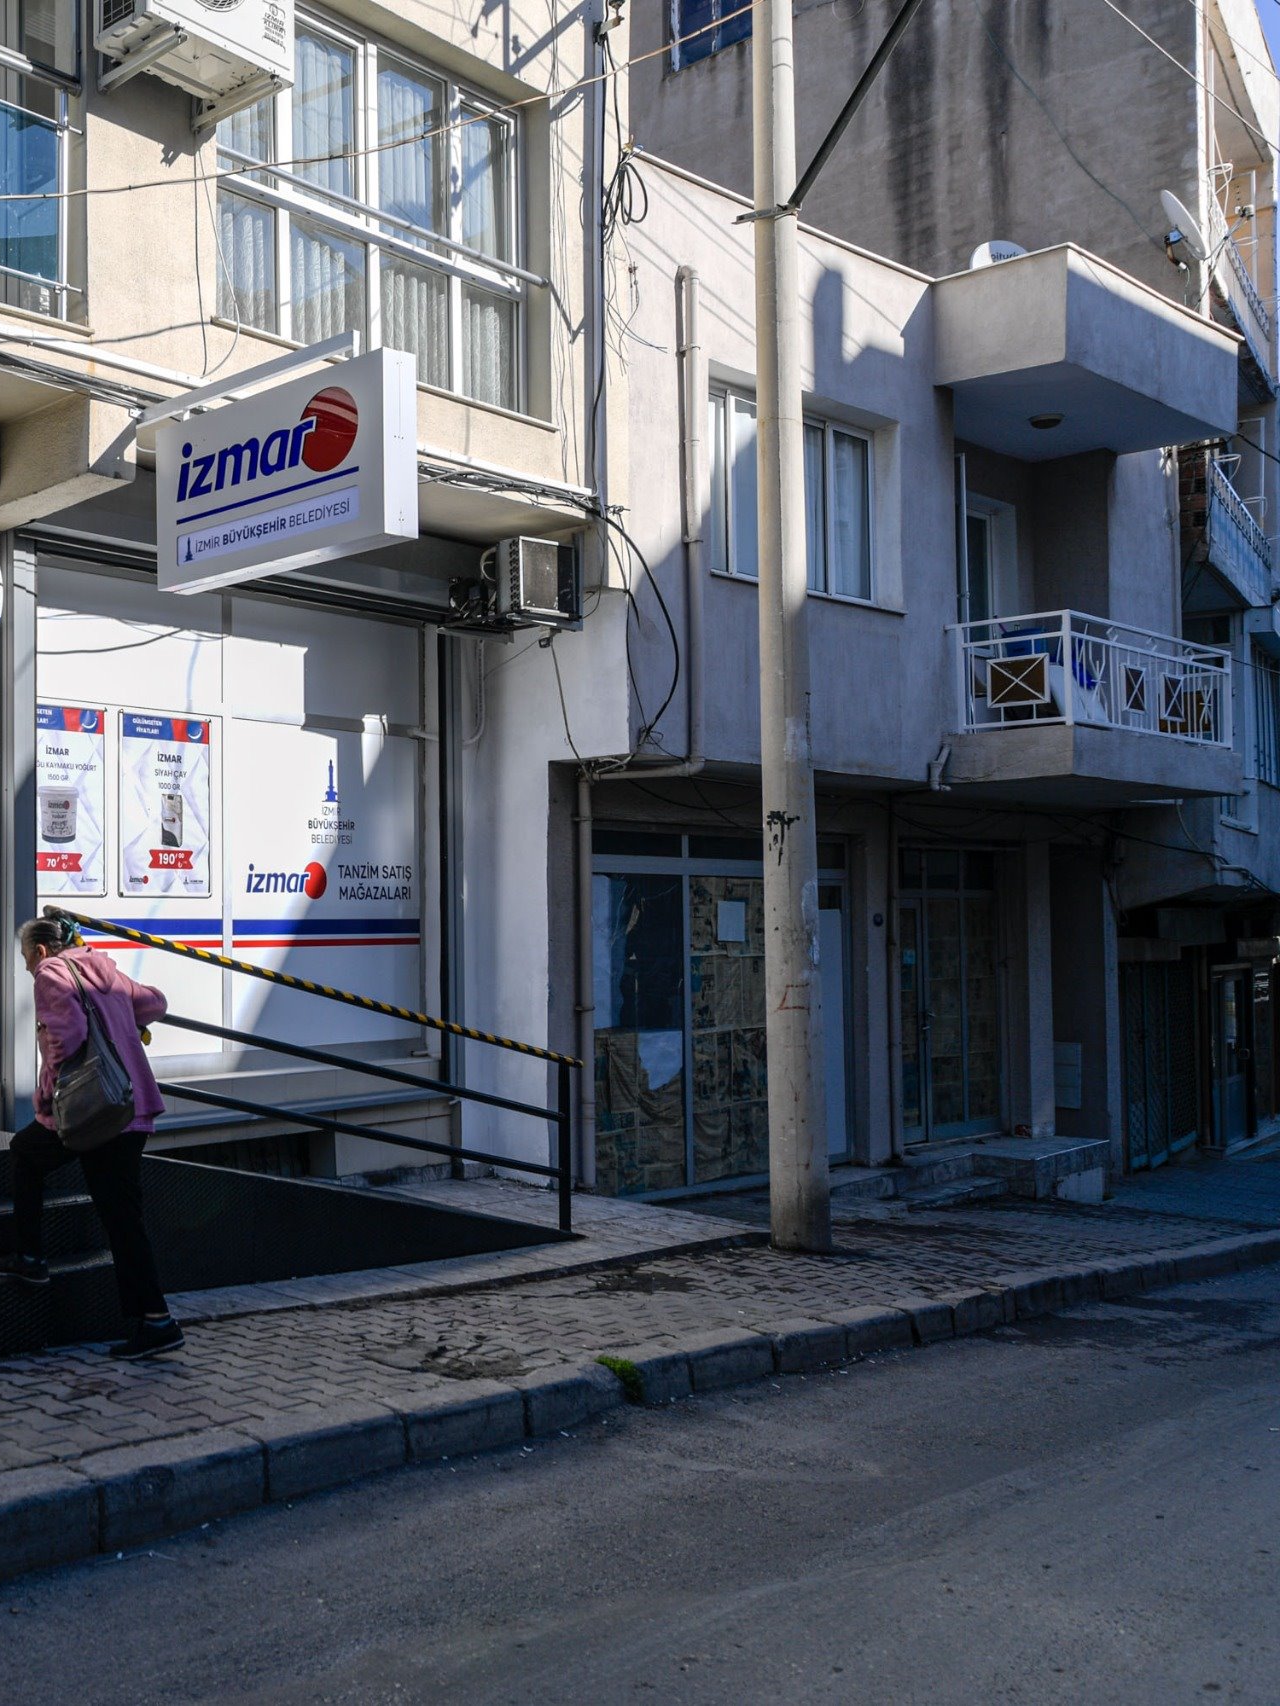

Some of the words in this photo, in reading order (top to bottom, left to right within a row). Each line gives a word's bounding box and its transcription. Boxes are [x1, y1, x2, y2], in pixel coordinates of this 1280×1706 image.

[176, 418, 315, 503] izmar
[195, 535, 221, 554] İZMİR
[222, 514, 287, 546] BÜYÜKŞEHİR
[289, 497, 350, 528] BELEDİYESİ
[45, 744, 70, 756] İZMAR
[157, 751, 182, 764] İZMAR
[75, 763, 97, 772] YOĞURT
[154, 768, 173, 777] SİYAH
[173, 770, 187, 781] ÇAY
[158, 782, 171, 790] 1000
[308, 818, 356, 831] BÜYÜKŞEHİR
[311, 834, 353, 845] BELEDİYESİ
[246, 863, 311, 893] izmar
[337, 862, 380, 879] TANZİM
[382, 864, 412, 882] SATIŞ
[339, 882, 412, 900] MAĞAZALARI
